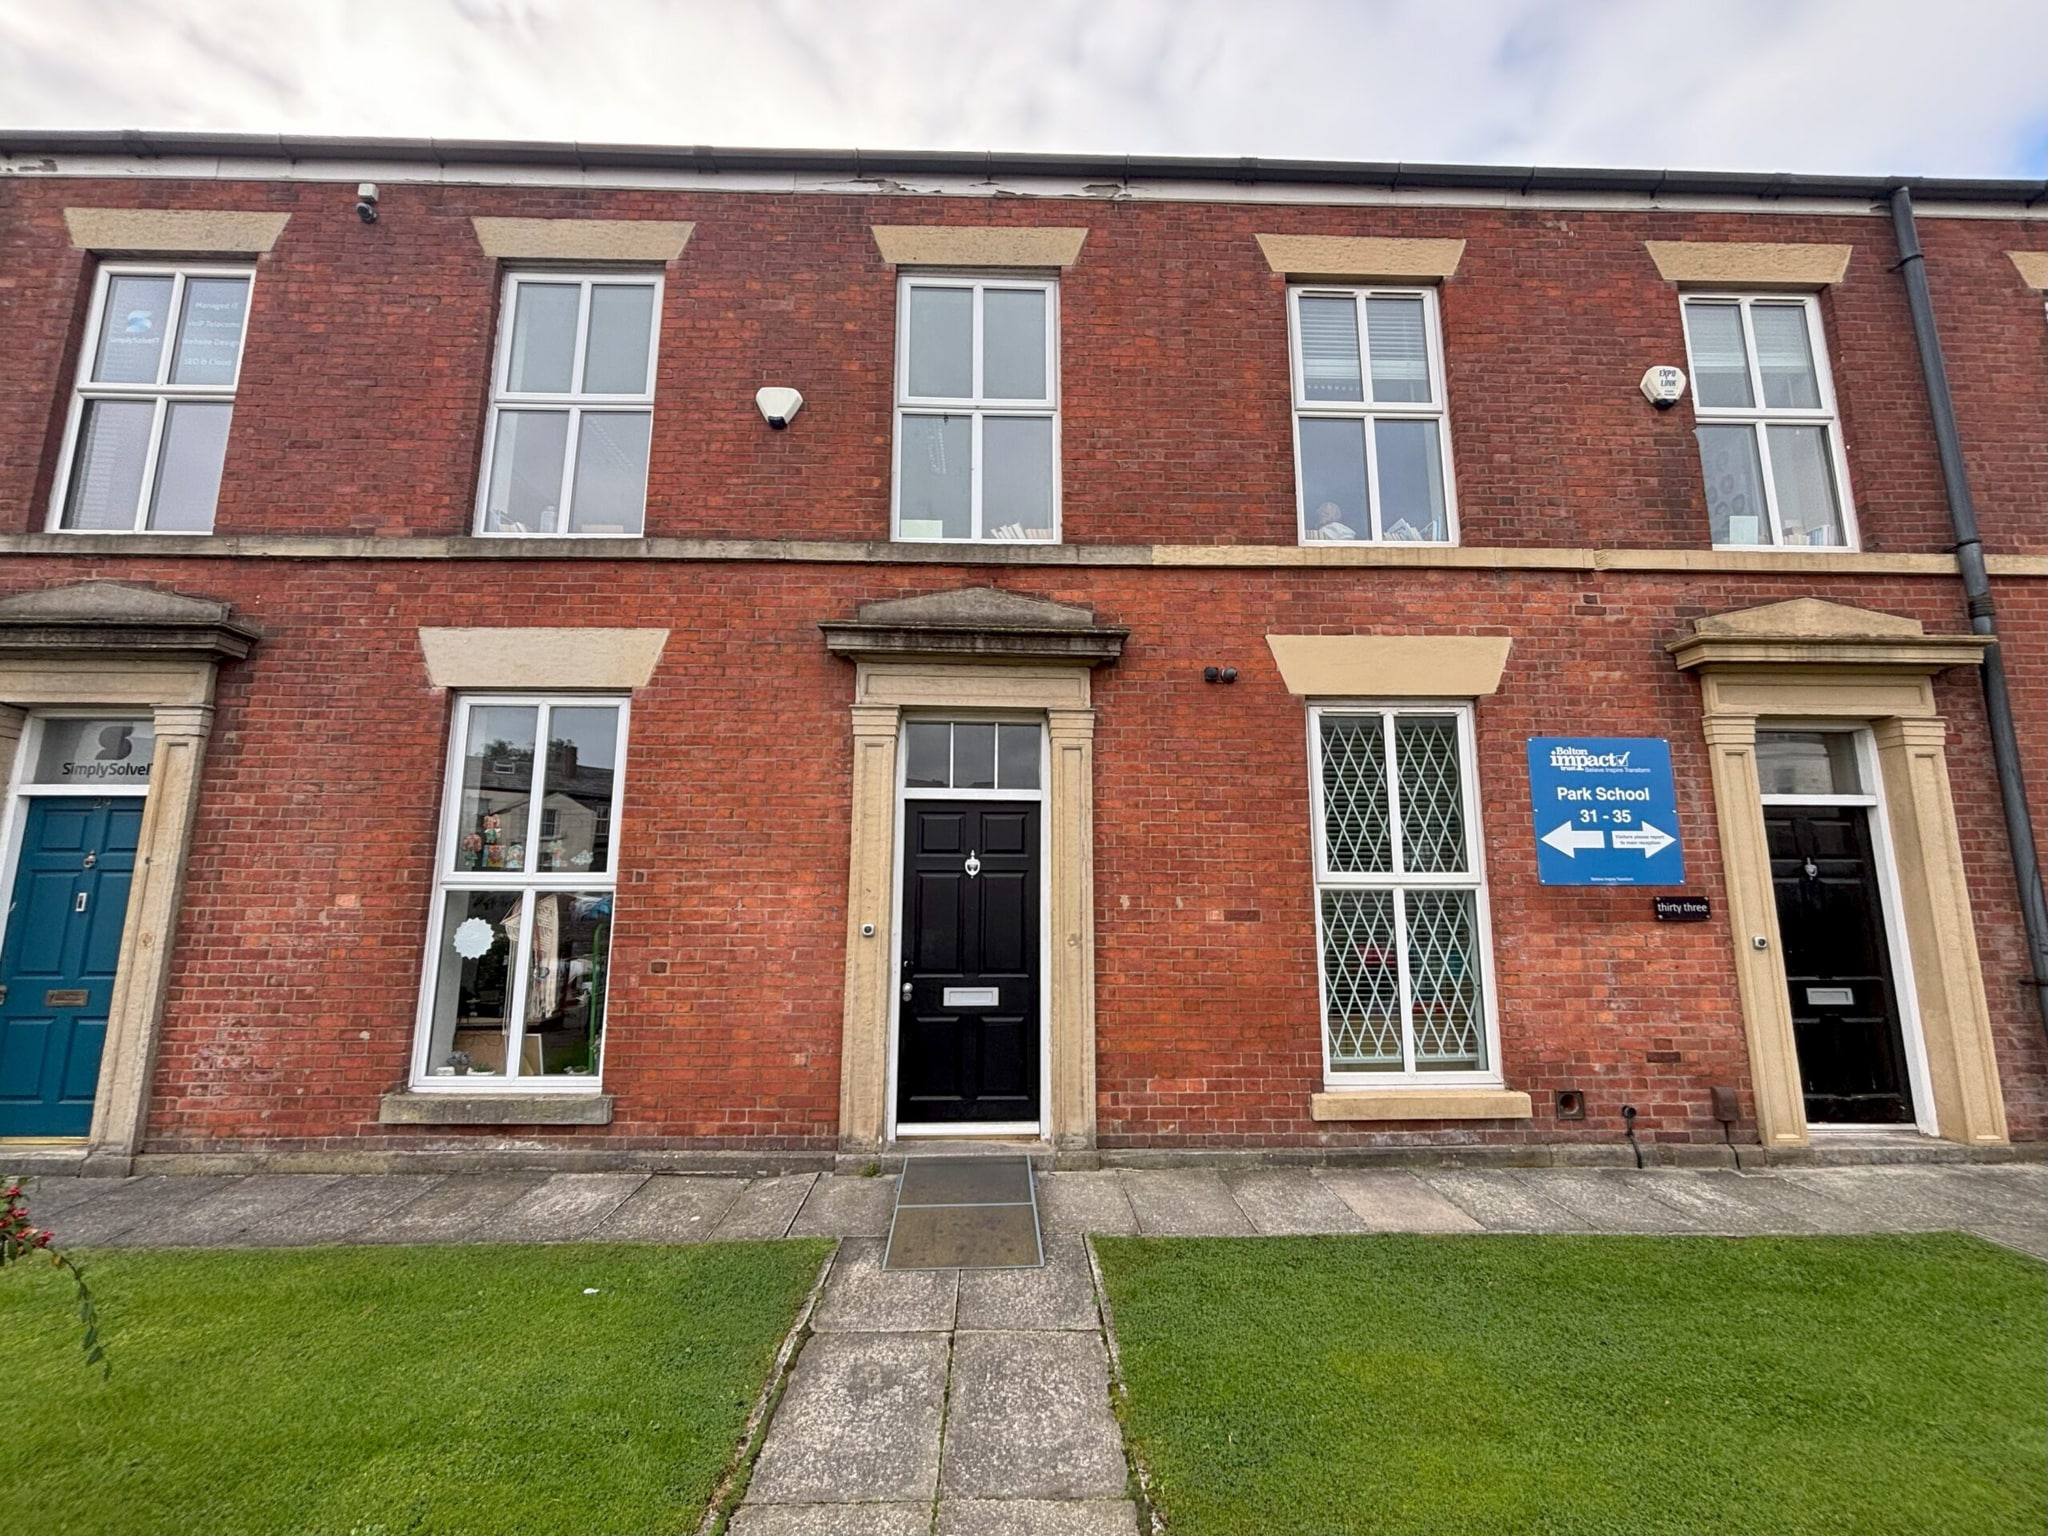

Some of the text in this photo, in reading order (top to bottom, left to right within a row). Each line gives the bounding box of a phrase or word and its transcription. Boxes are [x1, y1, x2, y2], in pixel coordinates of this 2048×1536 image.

[1659, 369, 1676, 378] EXPO
[1555, 746, 1588, 755] Bolton
[1550, 751, 1617, 771] impact
[1557, 787, 1649, 801] Park School
[1580, 809, 1597, 823] 31
[1612, 809, 1632, 823] 35
[1657, 902, 1708, 914] thirty three
